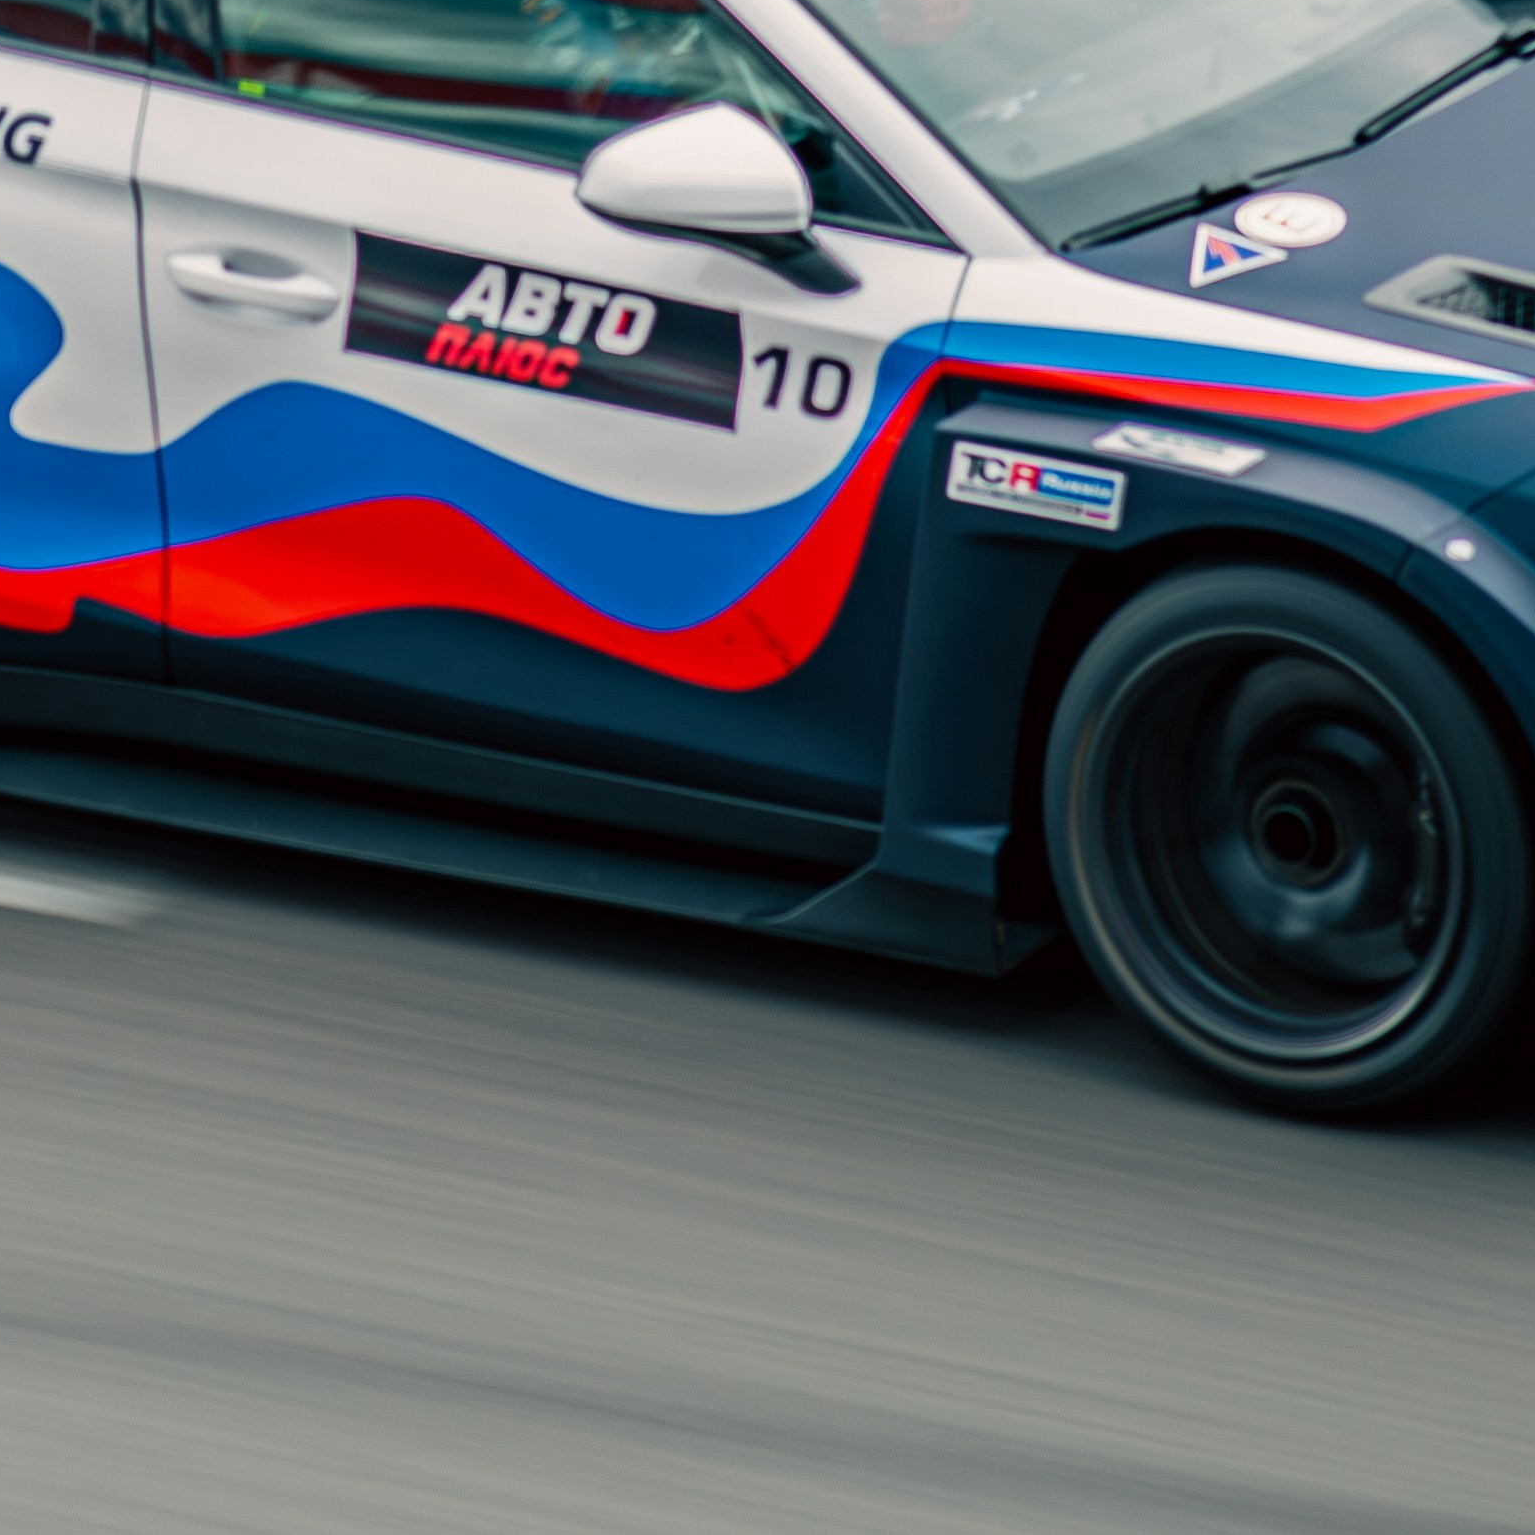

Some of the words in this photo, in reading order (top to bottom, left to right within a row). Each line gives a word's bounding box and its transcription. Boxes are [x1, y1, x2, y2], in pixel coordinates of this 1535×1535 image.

[445, 263, 657, 356] АВТО
[424, 321, 581, 389] ПЛЮС
[752, 345, 853, 419] 10
[963, 451, 1040, 492] TCR
